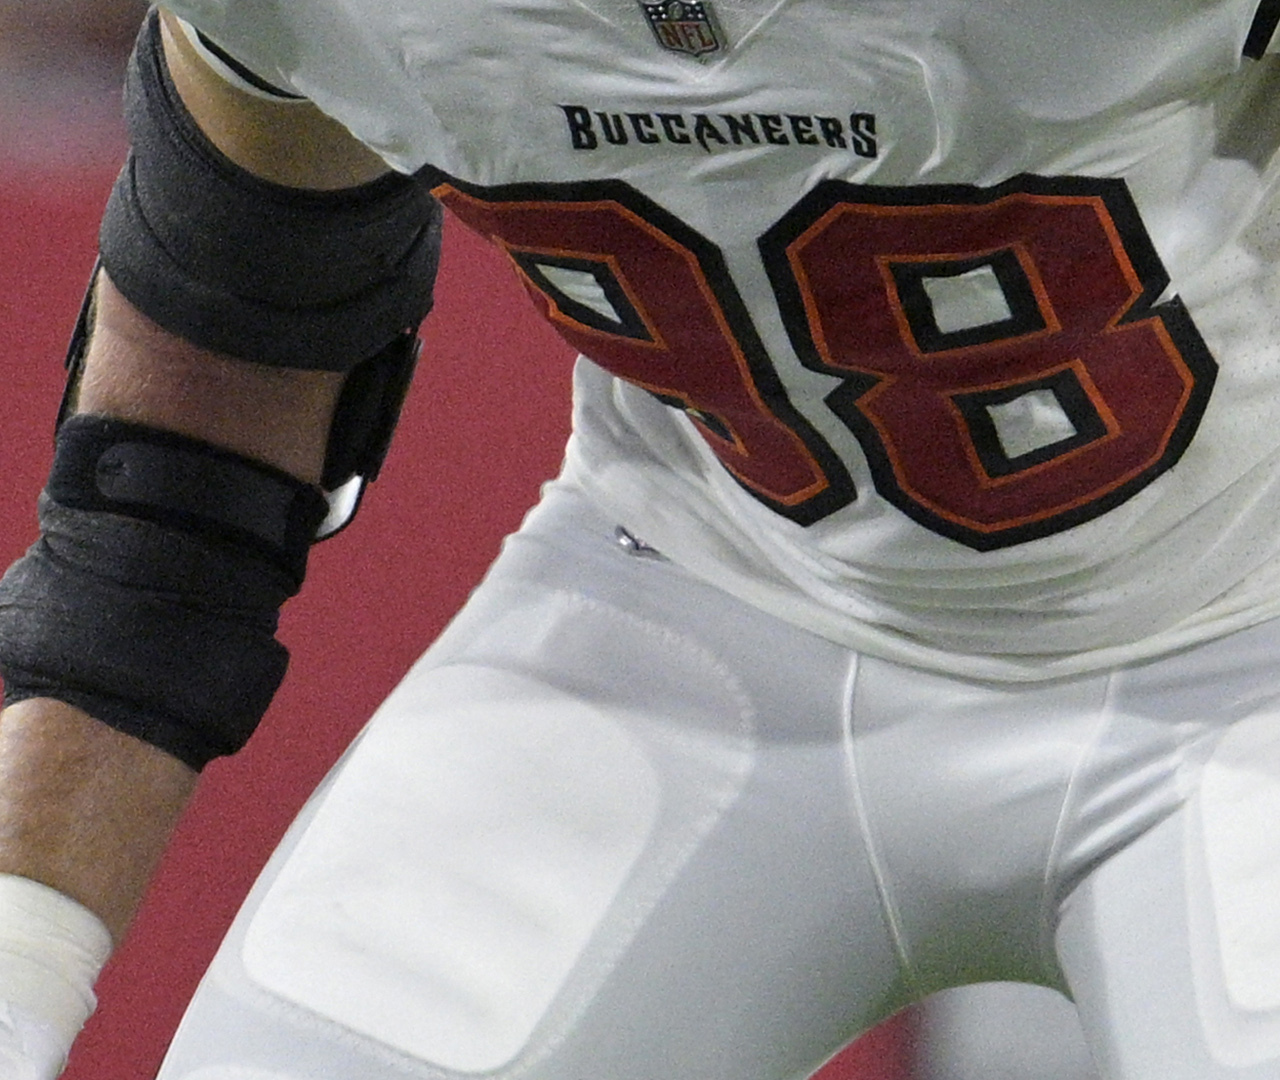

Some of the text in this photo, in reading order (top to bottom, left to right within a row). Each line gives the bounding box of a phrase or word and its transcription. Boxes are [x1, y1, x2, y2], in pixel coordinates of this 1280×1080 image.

[659, 21, 714, 49] NFL
[557, 104, 877, 158] BUCCANEERS
[419, 163, 1219, 552] 98
